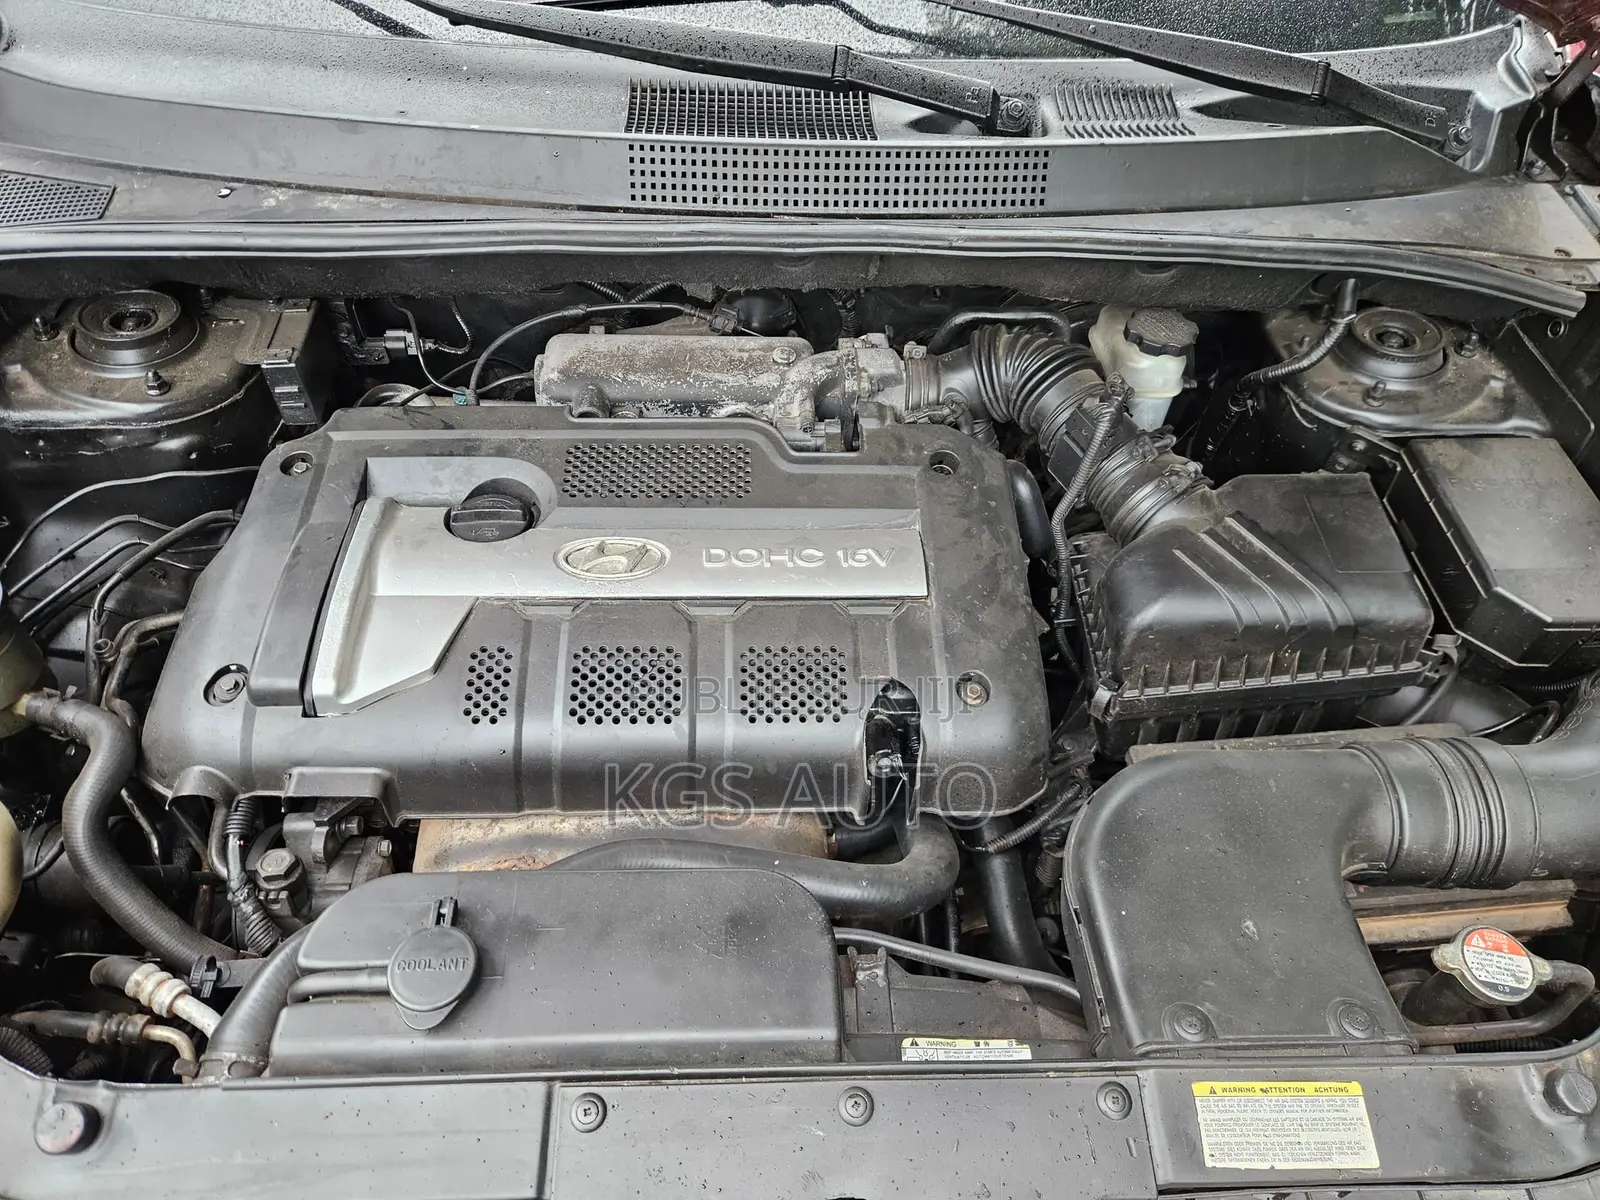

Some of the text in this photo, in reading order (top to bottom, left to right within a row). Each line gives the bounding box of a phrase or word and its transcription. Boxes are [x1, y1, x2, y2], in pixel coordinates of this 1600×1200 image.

[702, 547, 896, 568] DOHC 16V
[396, 957, 470, 973] COOLANT
[1497, 984, 1510, 993] 0.9
[925, 1040, 957, 1048] WARNING
[1221, 1086, 1256, 1094] WARNING
[1313, 1086, 1349, 1094] ACHTUNG
